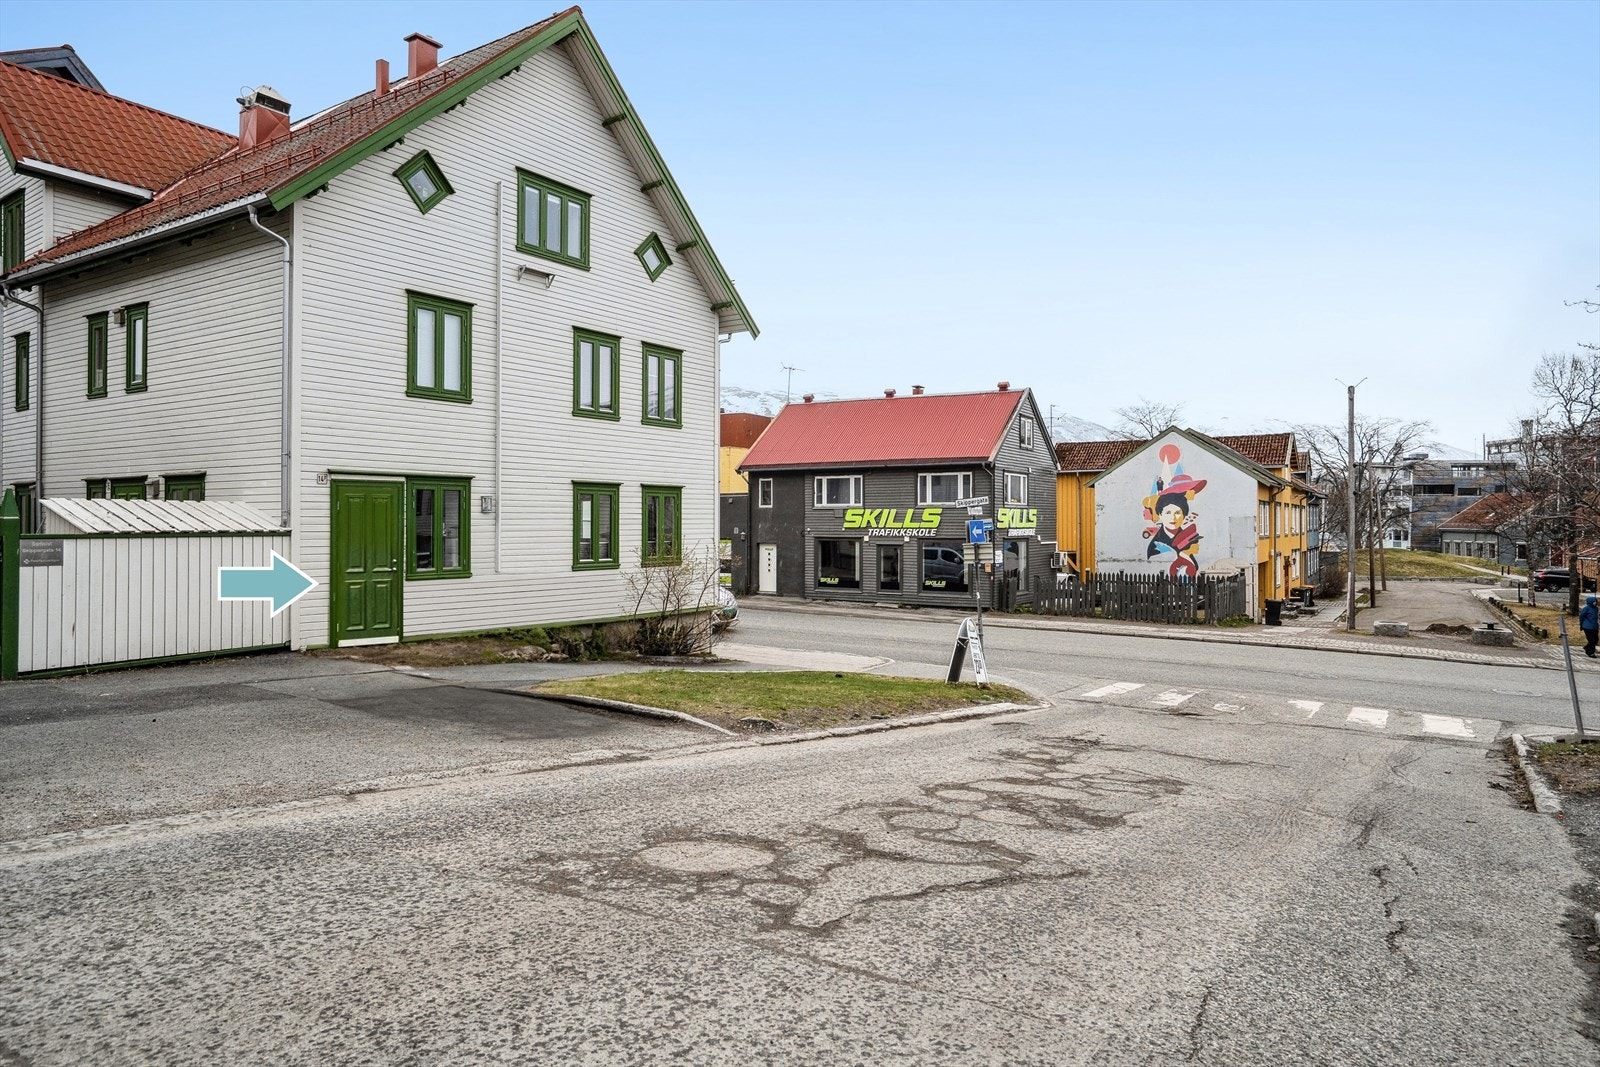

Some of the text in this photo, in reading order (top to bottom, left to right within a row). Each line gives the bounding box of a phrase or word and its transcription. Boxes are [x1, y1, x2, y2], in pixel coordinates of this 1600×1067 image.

[956, 497, 989, 507] Skippergata
[843, 508, 943, 528] SKILLS
[997, 508, 1038, 528] SKILLS
[868, 528, 938, 537] TRAFIKKSKOLE
